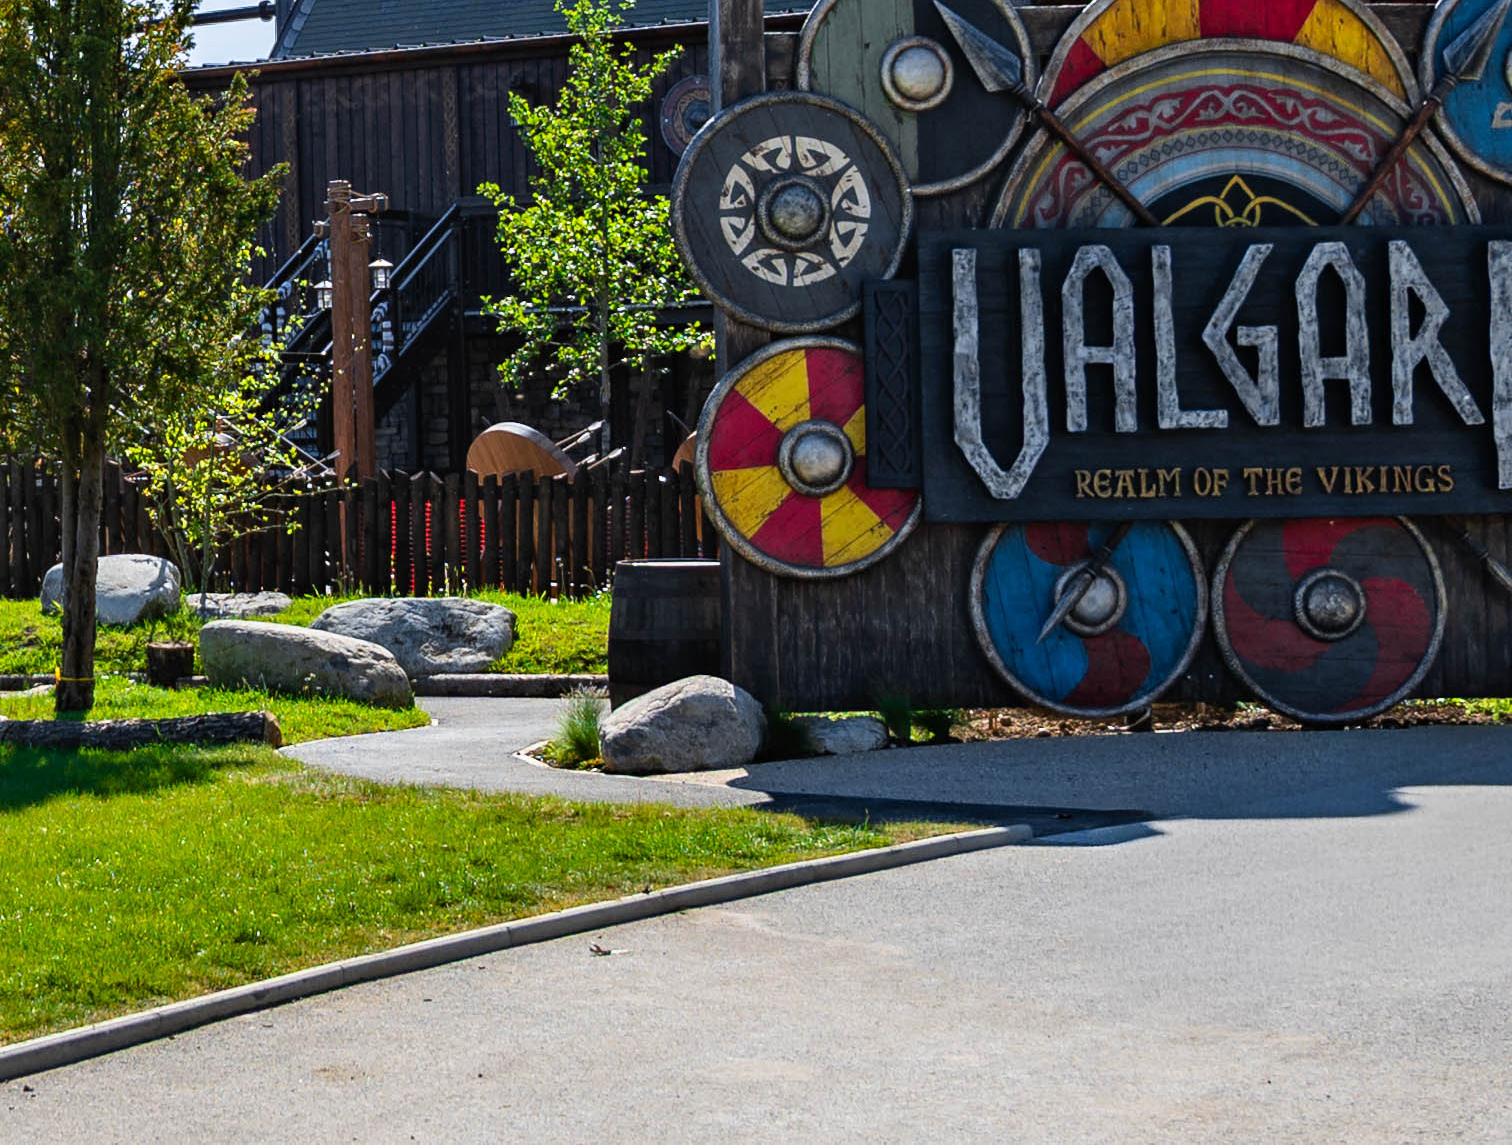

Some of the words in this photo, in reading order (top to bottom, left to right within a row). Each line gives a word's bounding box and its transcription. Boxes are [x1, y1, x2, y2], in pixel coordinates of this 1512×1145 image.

[1075, 467, 1182, 498] REALM
[1192, 466, 1230, 497] OF
[1243, 466, 1303, 496] THE
[1316, 464, 1456, 495] VIKINGS
